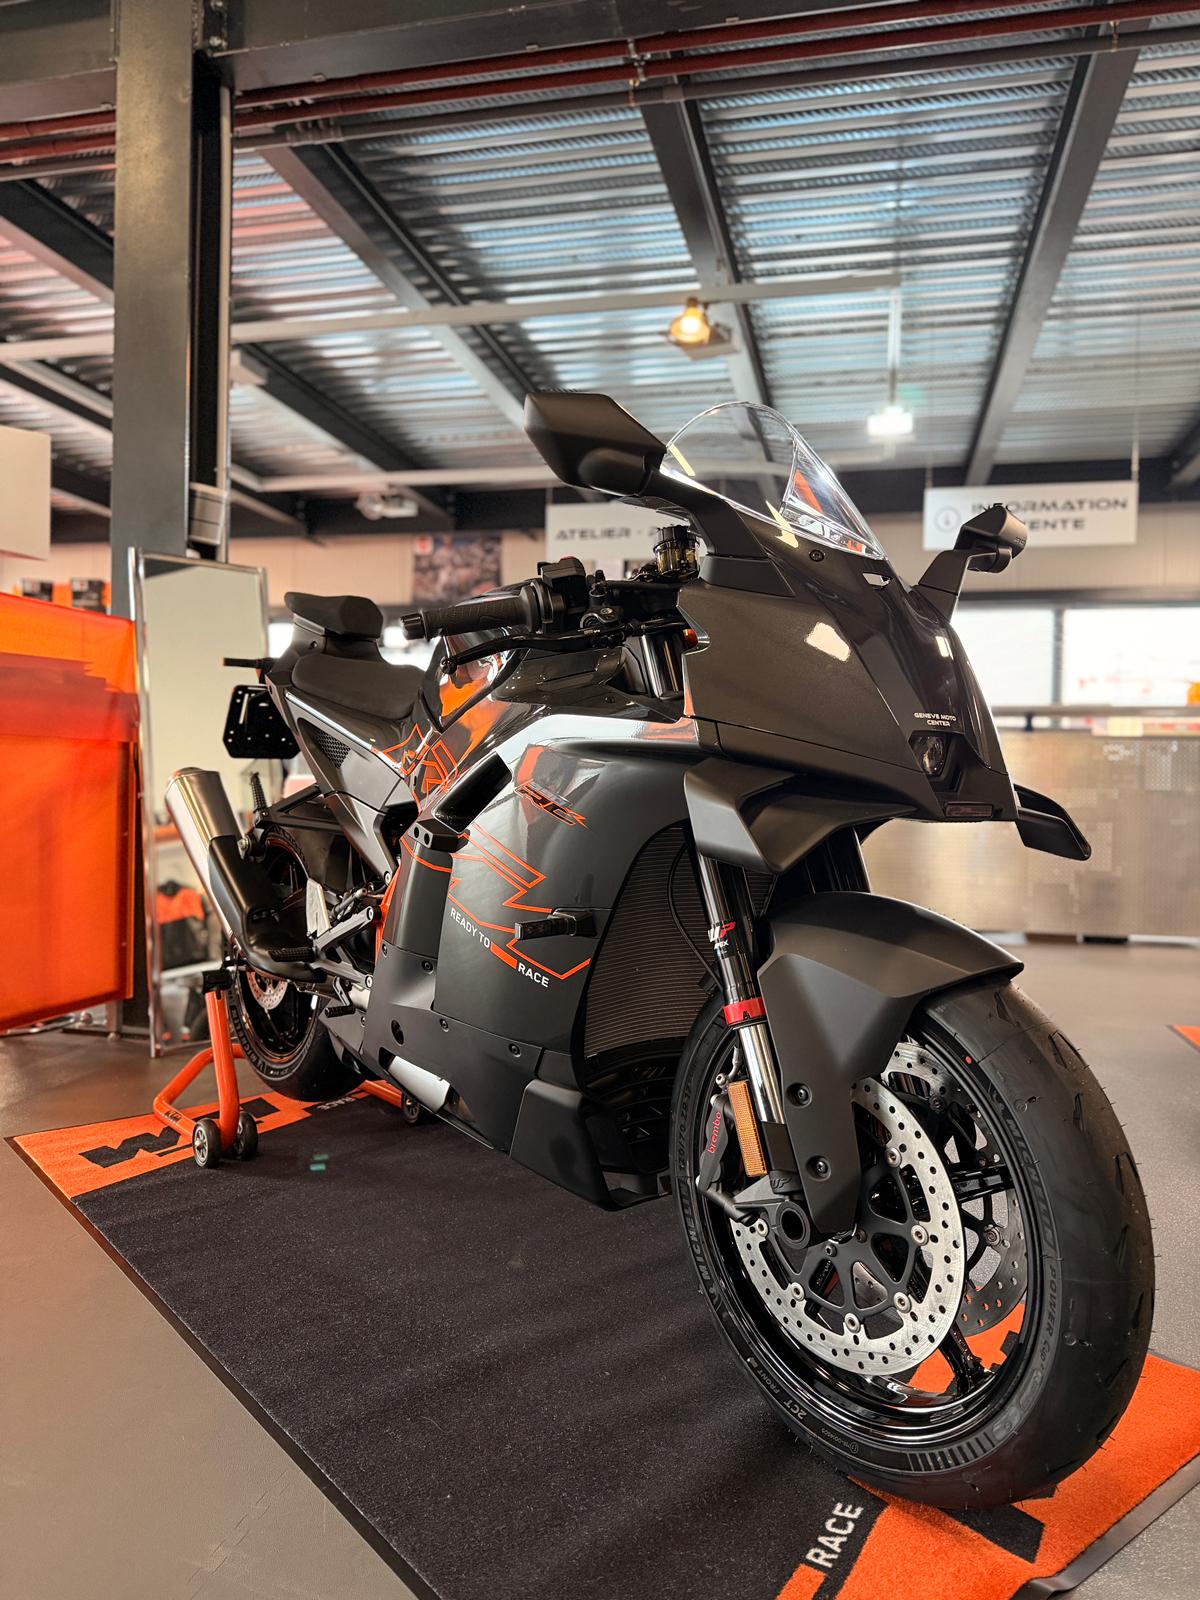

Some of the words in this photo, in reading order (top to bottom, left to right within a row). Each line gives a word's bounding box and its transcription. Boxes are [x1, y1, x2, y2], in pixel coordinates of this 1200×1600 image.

[972, 497, 1128, 513] INORMATION
[556, 526, 632, 540] ATELIER
[1028, 518, 1086, 531] ENTE
[450, 907, 478, 936] READY
[478, 931, 491, 949] TO
[517, 962, 550, 988] RACE
[163, 1109, 182, 1123] KTM
[708, 1111, 722, 1154] brembo
[1046, 1265, 1057, 1337] POWER
[757, 1370, 780, 1394] FRONT
[784, 1400, 807, 1420] 2CT
[805, 1502, 864, 1568] RACE
